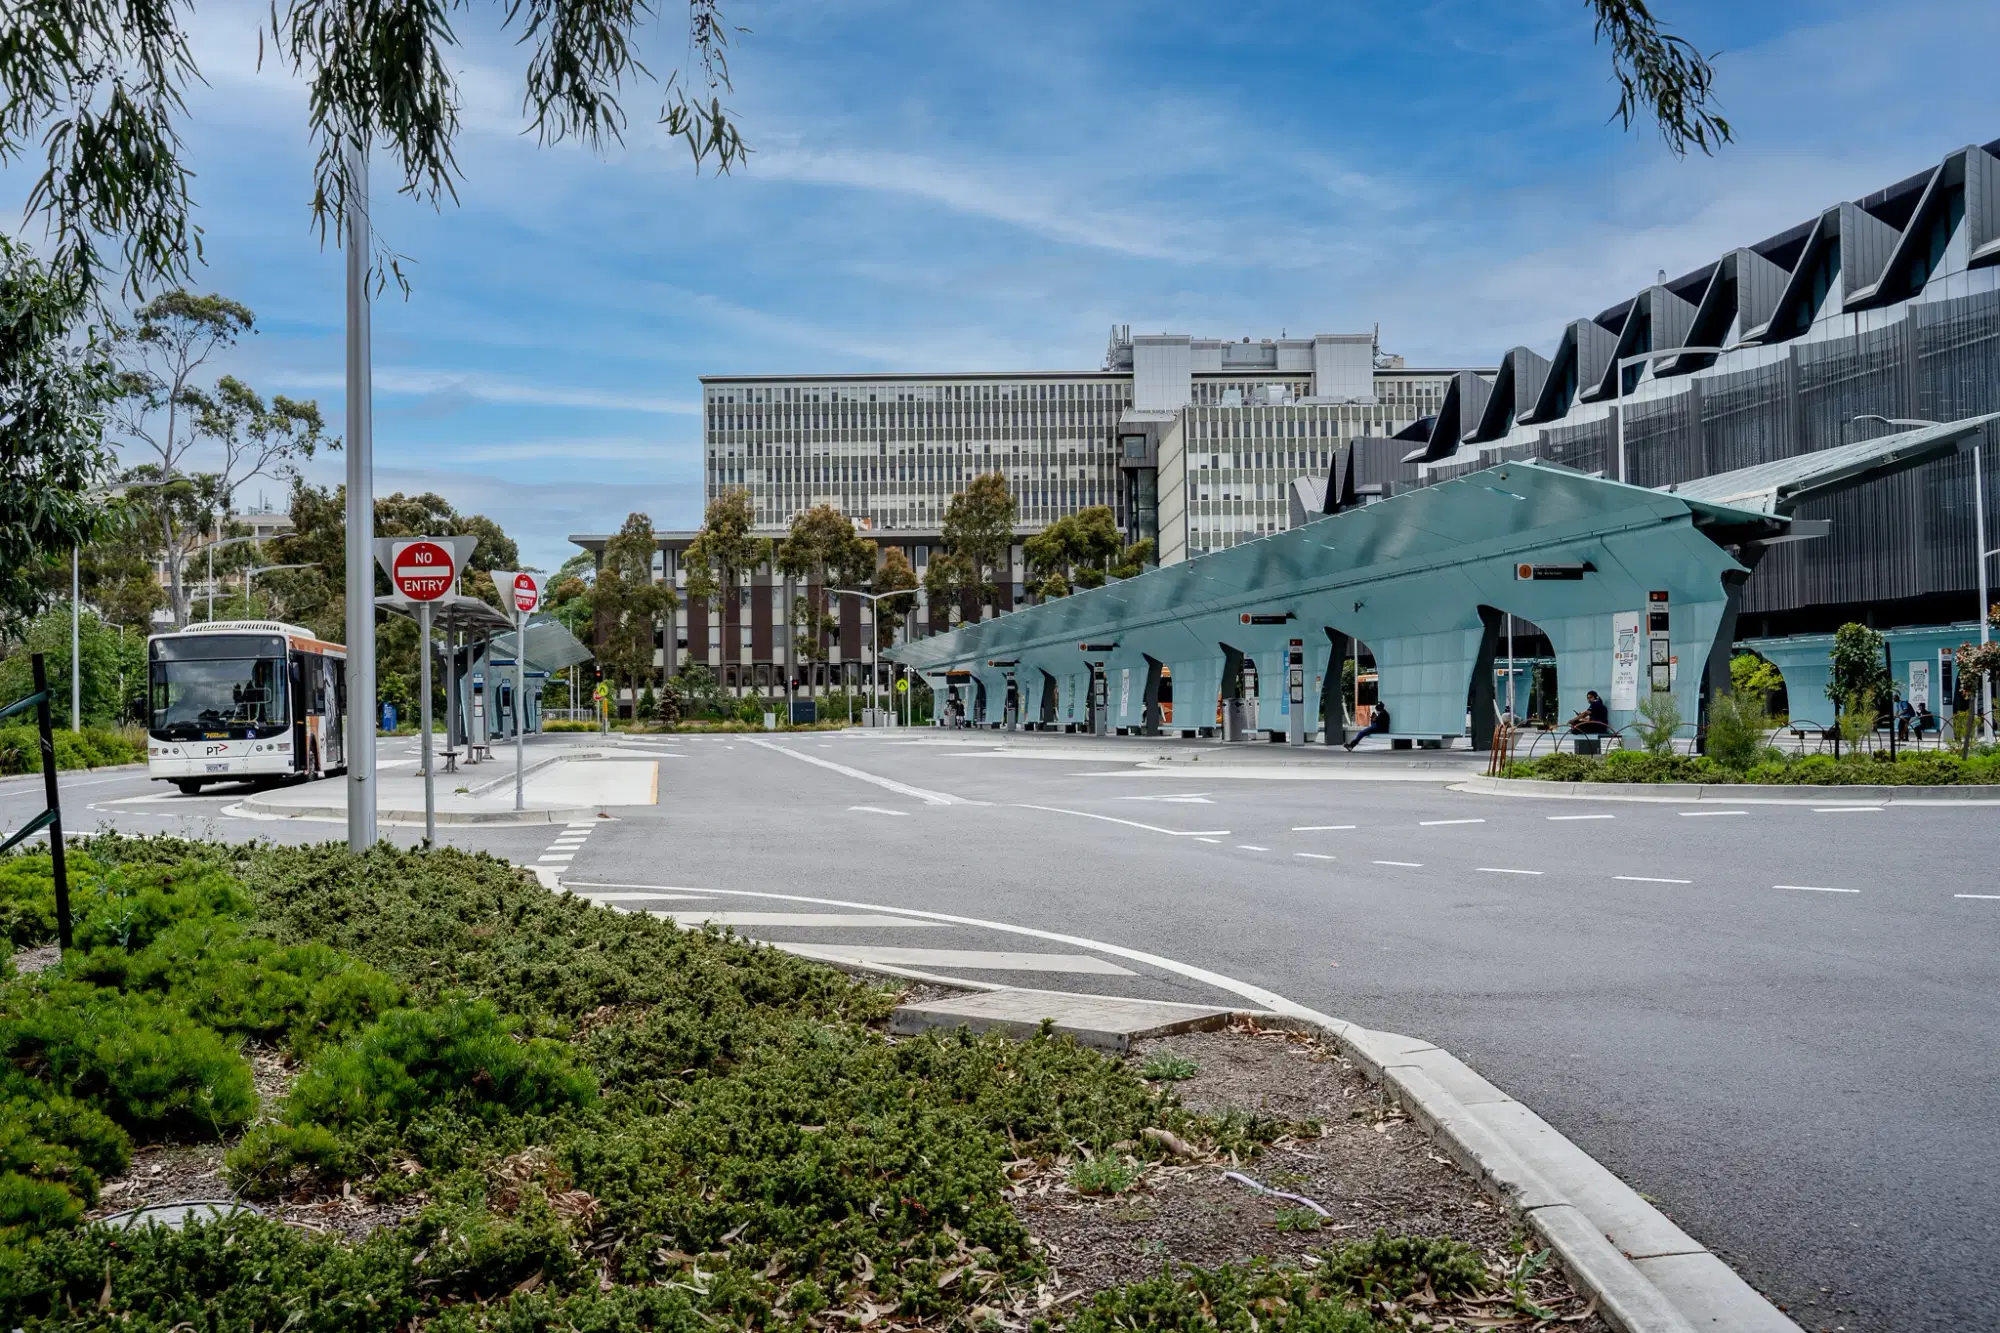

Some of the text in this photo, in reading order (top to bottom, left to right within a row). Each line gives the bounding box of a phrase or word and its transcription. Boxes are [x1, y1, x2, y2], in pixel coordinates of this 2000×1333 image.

[415, 552, 432, 563] NO
[404, 580, 445, 592] ENTRY
[519, 580, 528, 588] NO
[516, 597, 533, 606] ENTRY
[206, 746, 220, 755] PT
